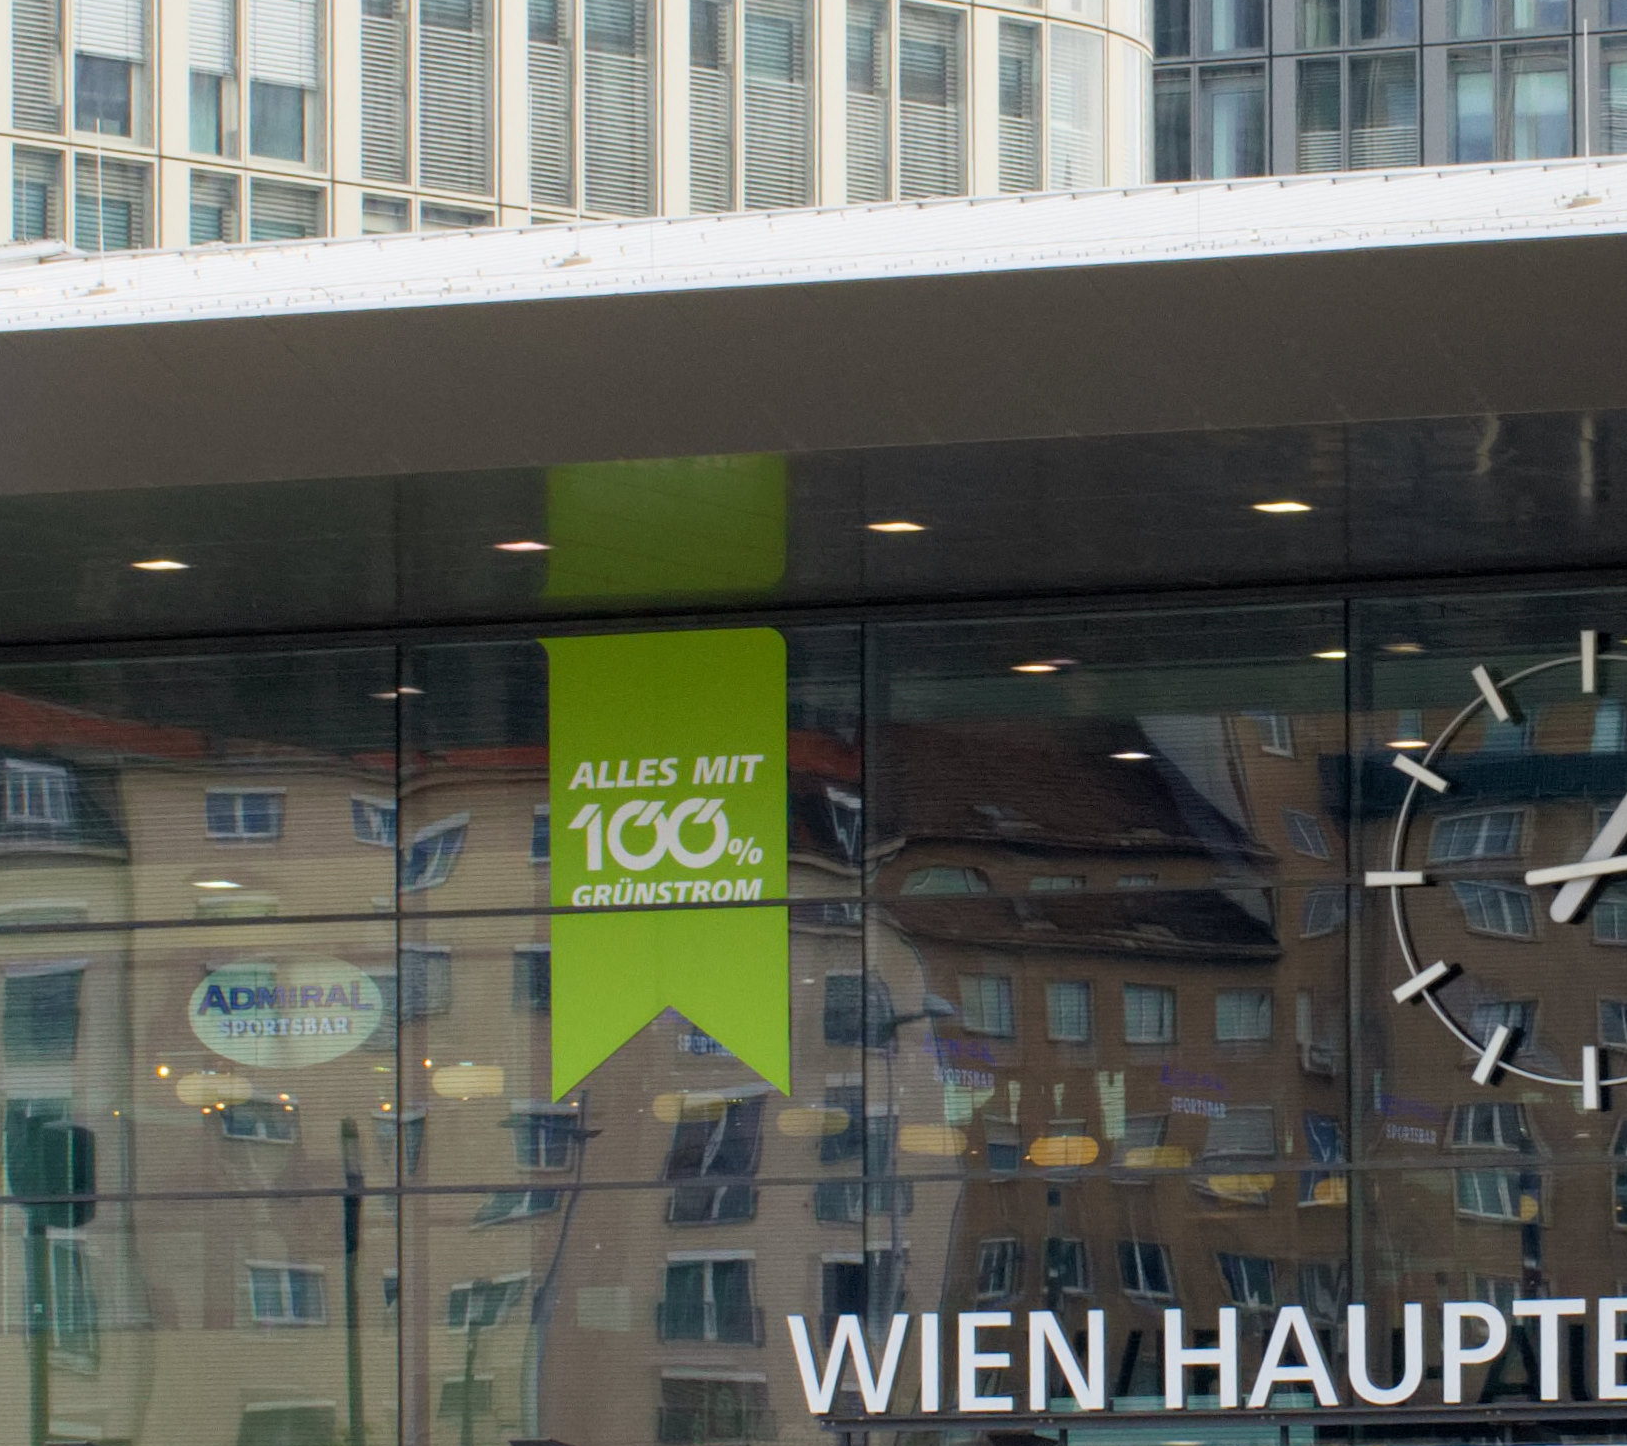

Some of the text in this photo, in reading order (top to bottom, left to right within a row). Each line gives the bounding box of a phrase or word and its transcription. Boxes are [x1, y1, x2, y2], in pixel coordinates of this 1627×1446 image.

[568, 754, 765, 791] ALLES MIT
[572, 877, 763, 907] GRÜNSTROM
[197, 980, 374, 1016] ADMIRAL
[220, 1016, 349, 1038] SPORTSBAR
[786, 1308, 1106, 1415] WIEN
